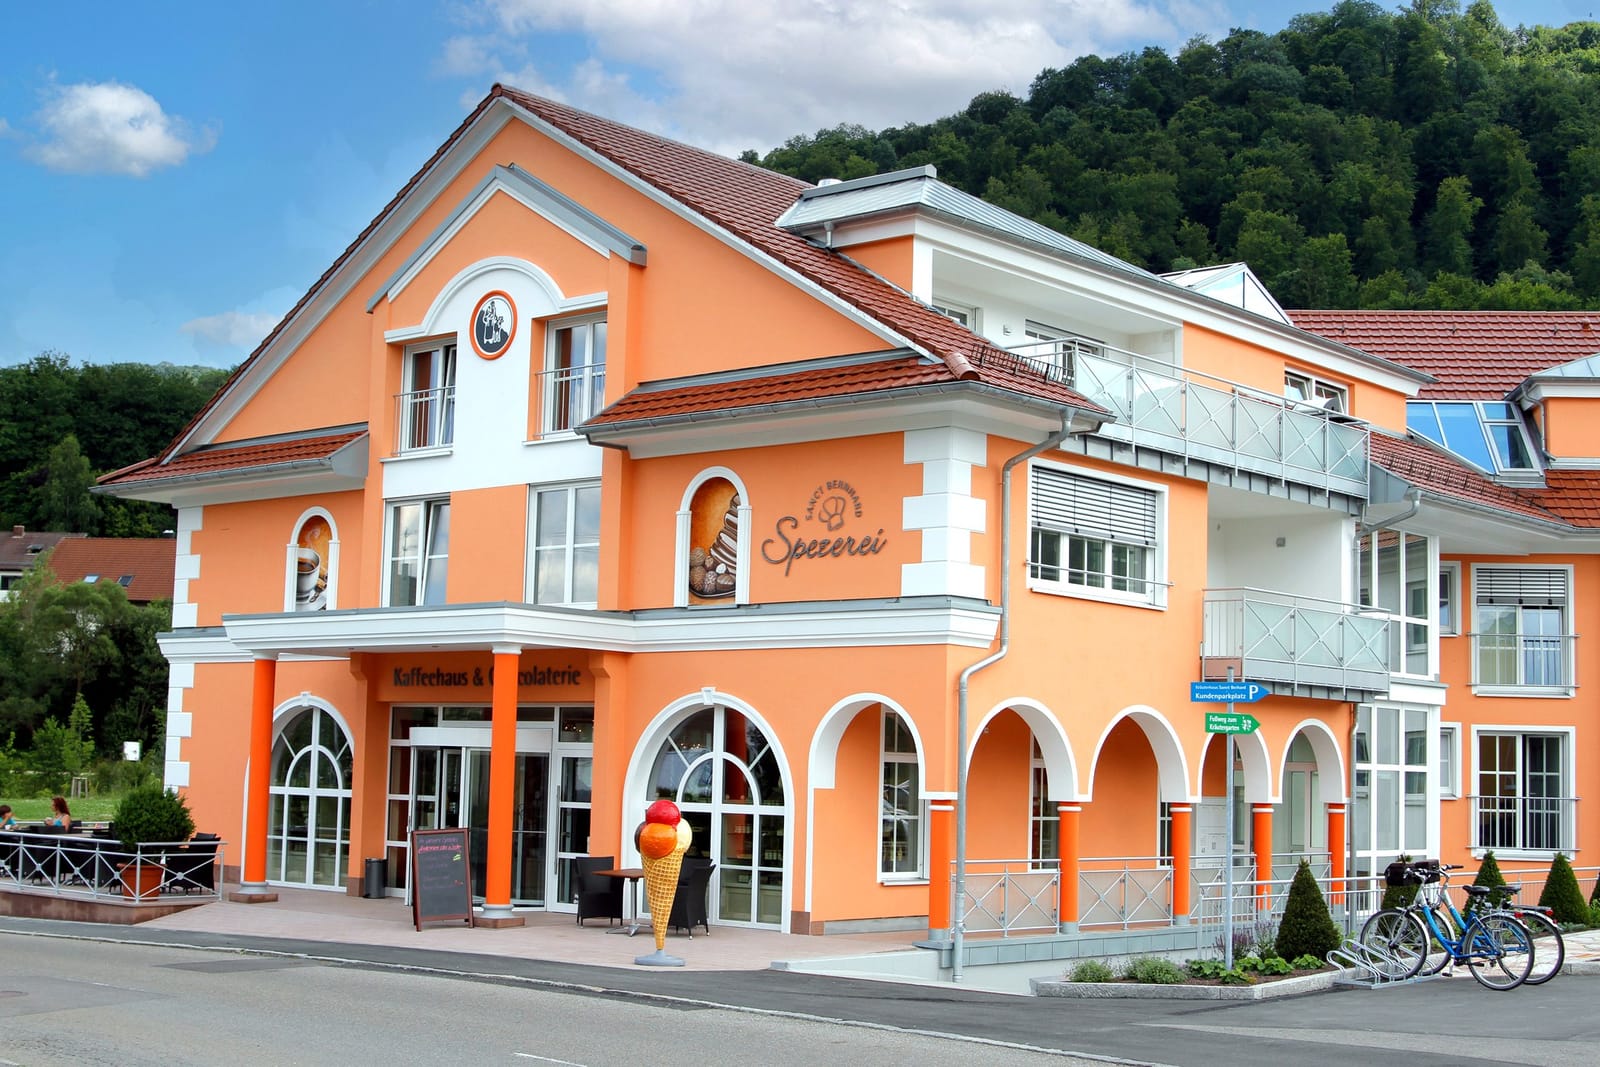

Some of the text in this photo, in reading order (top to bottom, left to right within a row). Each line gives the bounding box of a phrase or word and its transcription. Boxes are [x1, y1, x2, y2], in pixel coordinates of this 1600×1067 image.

[805, 480, 863, 521] SANCT BERNHARD
[761, 516, 887, 577] Spezerei
[393, 665, 581, 687] Kaffeehaus & Ccolaterie
[1249, 685, 1259, 700] P
[1209, 724, 1240, 732] Kräutergarten
